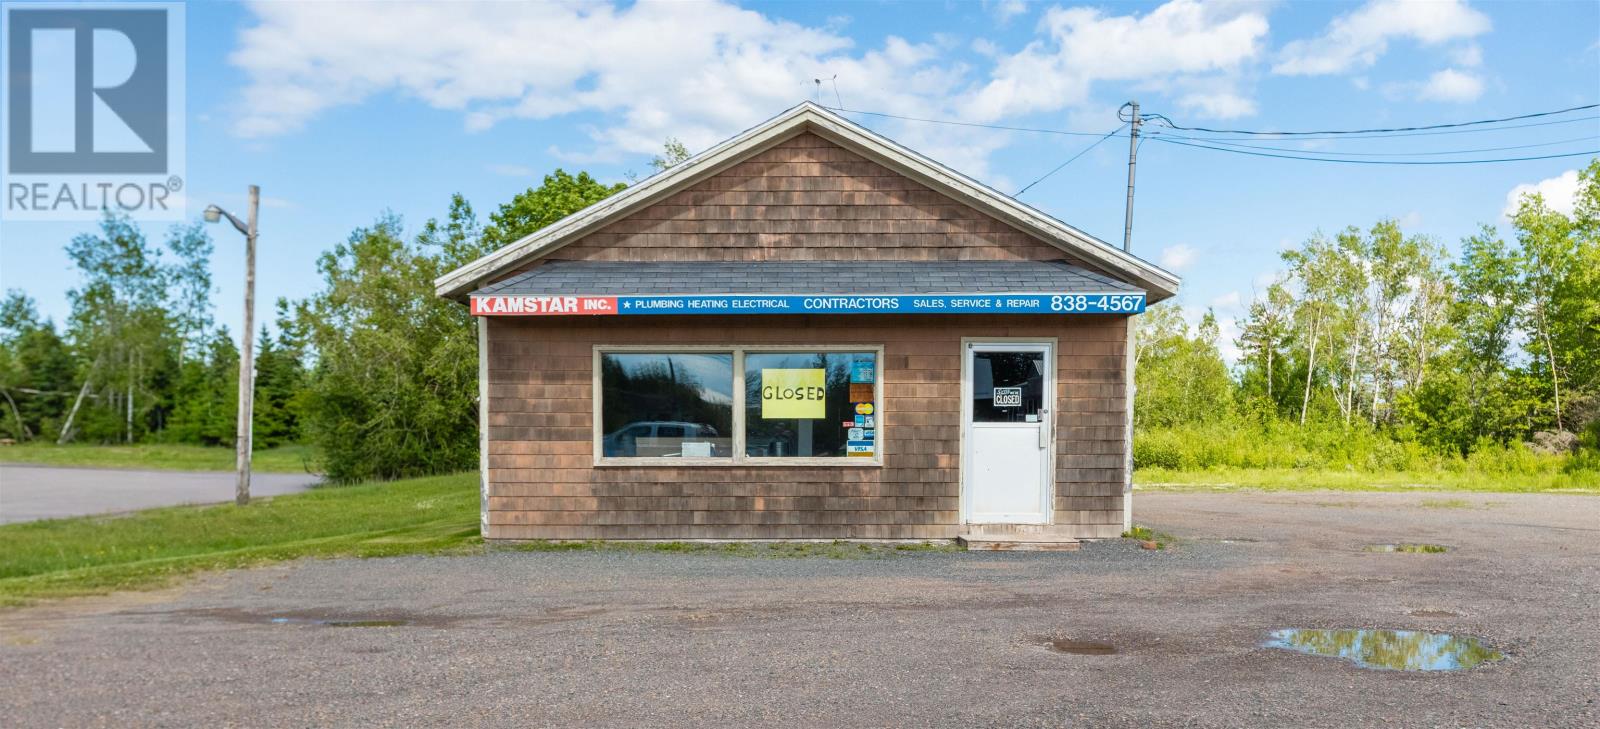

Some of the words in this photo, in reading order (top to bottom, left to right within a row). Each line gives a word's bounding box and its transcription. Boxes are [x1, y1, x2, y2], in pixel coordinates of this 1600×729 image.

[476, 296, 578, 313] KAMSTAR
[583, 299, 612, 310] INC.
[635, 300, 684, 309] PLUMBING
[687, 300, 728, 309] HEATING
[732, 299, 789, 308] ELECTRICAL
[803, 298, 899, 309] CONTRACTORS
[913, 299, 947, 309] SALES,
[950, 299, 991, 308] SERVICE
[995, 299, 1002, 308] &
[1006, 299, 1040, 308] REPAIR
[1050, 295, 1144, 311] 838-4567
[996, 395, 1020, 404] CLOSED
